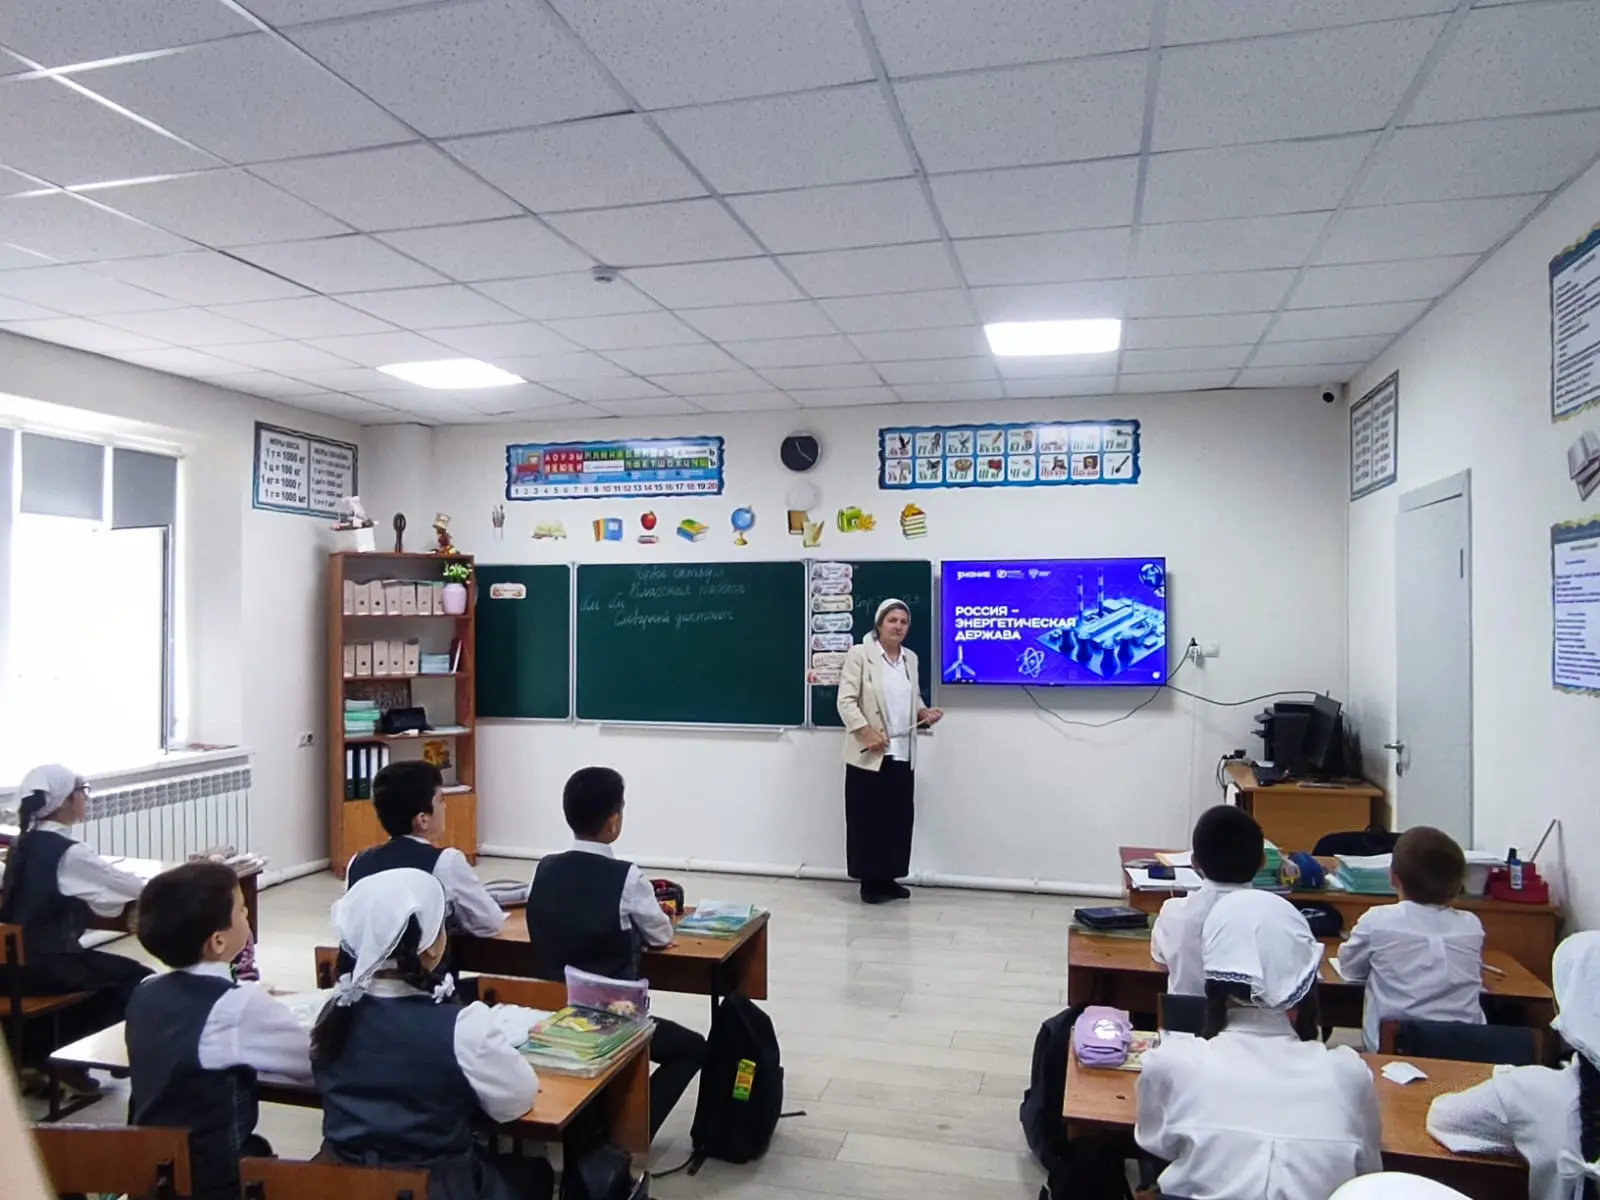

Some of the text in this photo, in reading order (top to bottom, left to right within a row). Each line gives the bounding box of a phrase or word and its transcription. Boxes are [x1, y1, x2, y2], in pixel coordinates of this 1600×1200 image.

[634, 484, 642, 492] 13
[697, 482, 706, 490] 19
[955, 606, 1008, 617] РОССИЯ
[955, 617, 1077, 629] ЭНЕРГЕТИЧЕСКАЯ
[954, 630, 1022, 642] ДЕРЖАВА
